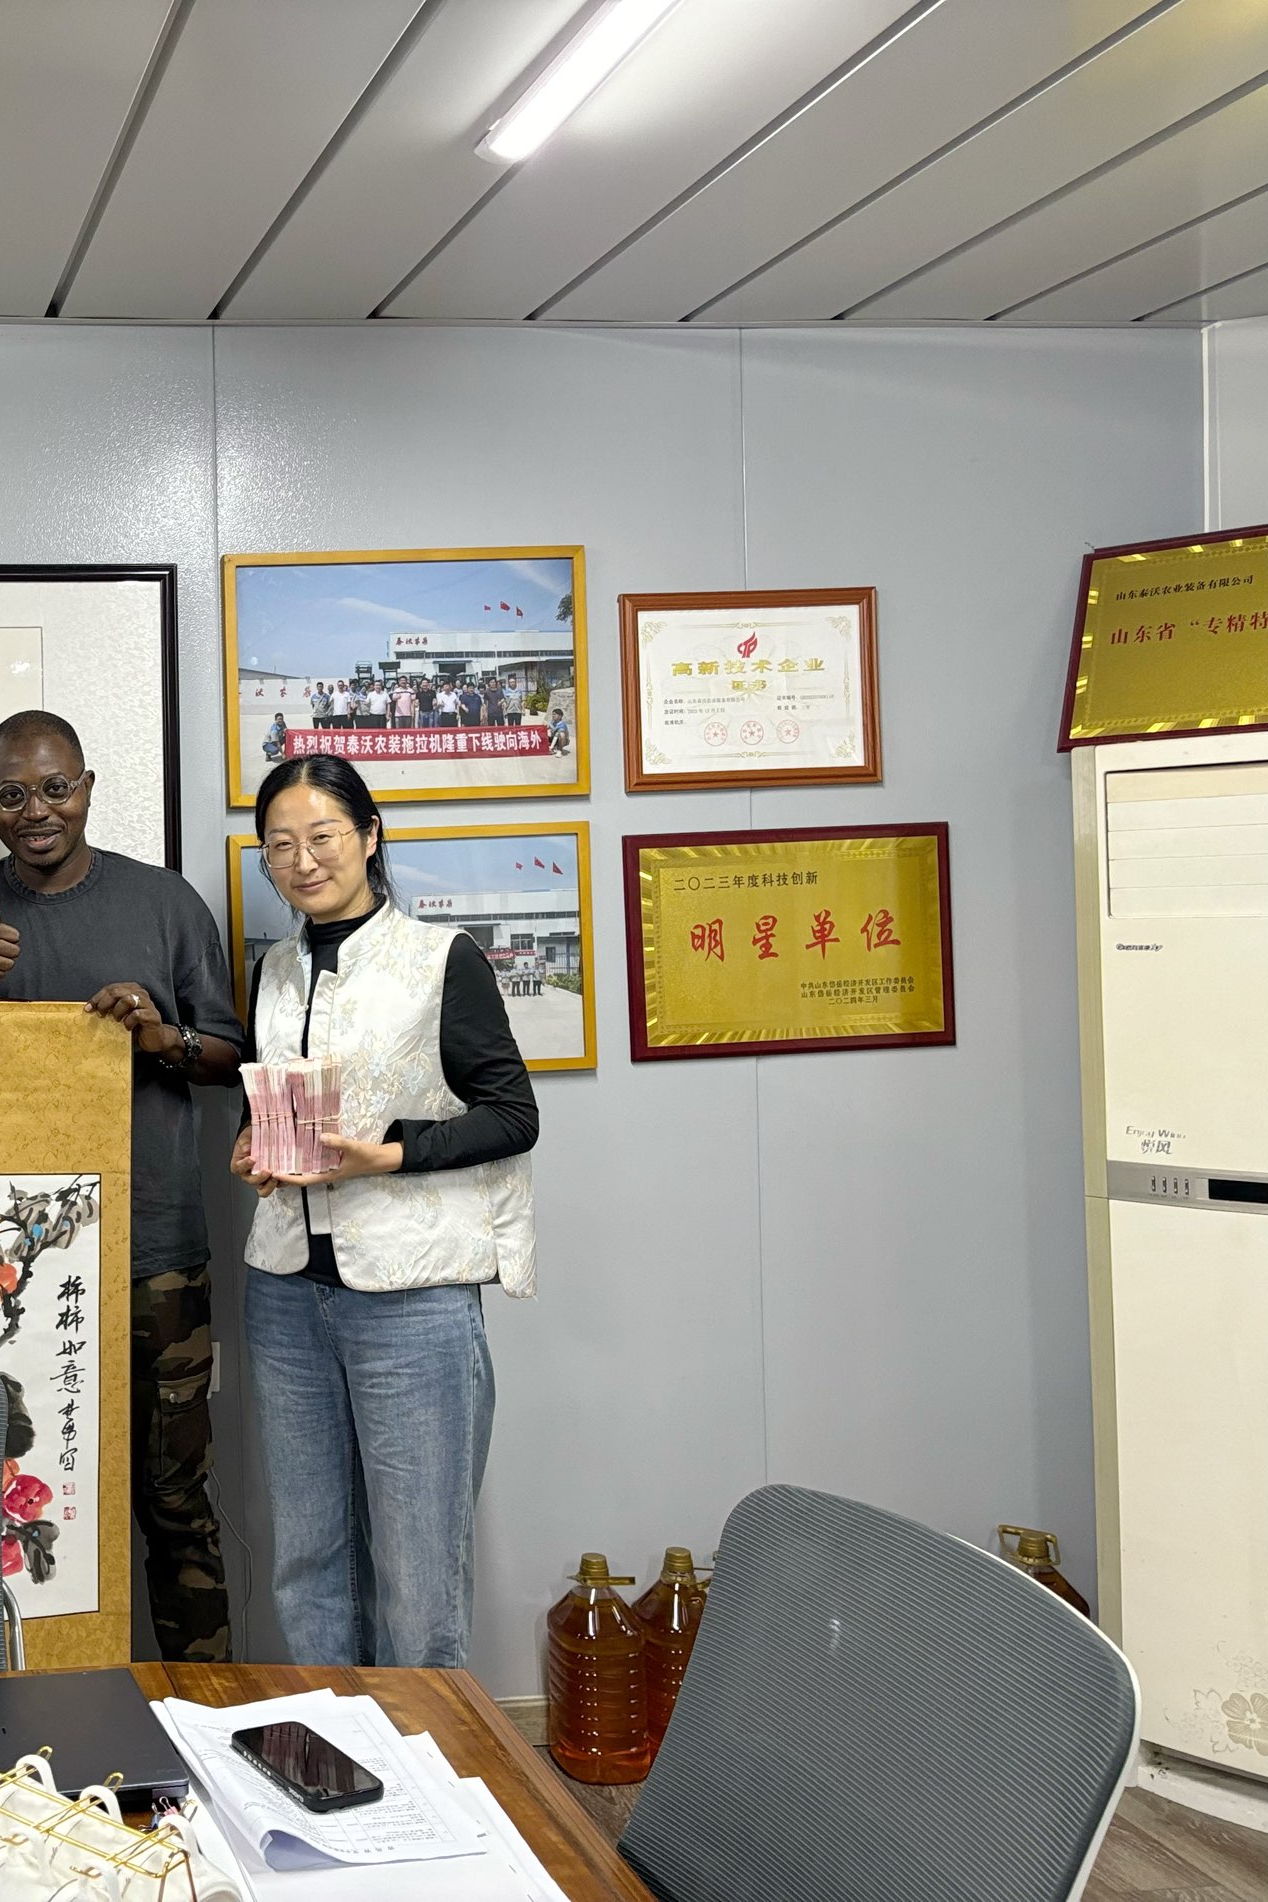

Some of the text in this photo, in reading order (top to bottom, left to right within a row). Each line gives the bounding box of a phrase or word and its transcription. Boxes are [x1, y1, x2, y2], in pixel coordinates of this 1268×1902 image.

[1116, 575, 1254, 600] 山东泰沃农业装备有限公司
[672, 658, 825, 677] 高新技术企业
[292, 730, 542, 756] 热烈祝贺泰沃农装拖拉机隆重下线驶向海外
[690, 909, 901, 962] 明星单位
